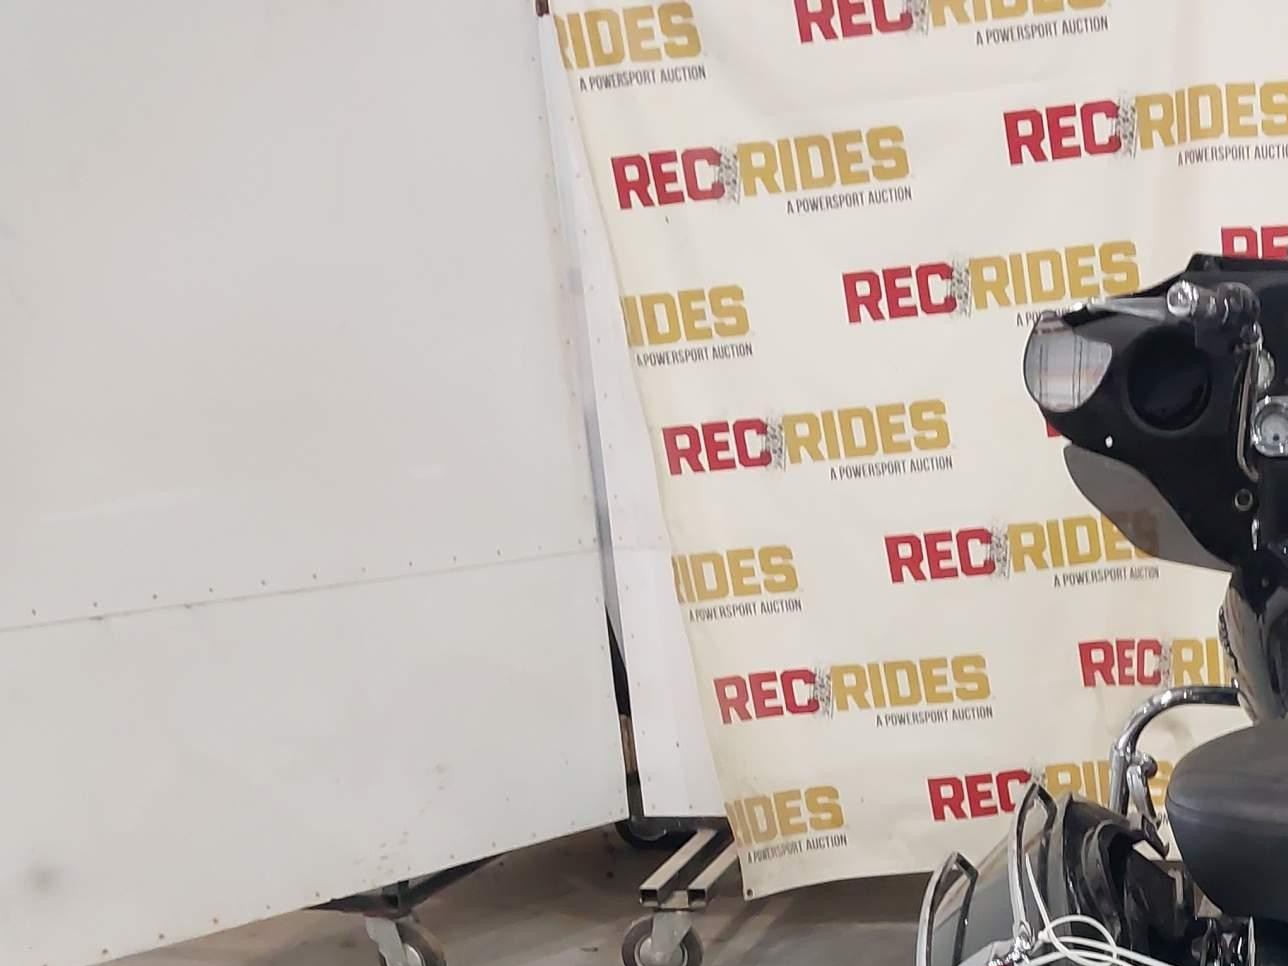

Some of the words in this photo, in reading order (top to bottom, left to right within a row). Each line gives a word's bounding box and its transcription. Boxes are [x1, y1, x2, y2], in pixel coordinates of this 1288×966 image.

[794, 0, 912, 43] REC
[976, 30, 984, 46] A
[985, 20, 1058, 45] POWERSPORT
[1061, 15, 1109, 36] AUCTION
[579, 76, 588, 92] A
[588, 68, 656, 91] POWERSPORT
[660, 64, 707, 84] AUCTION
[1003, 100, 1122, 166] REC
[1177, 151, 1184, 167] A
[1184, 144, 1250, 165] POWERSPORT
[611, 149, 724, 210] REC
[735, 125, 910, 197] RIDES
[786, 199, 795, 215] A
[795, 191, 865, 214] POWERSPORT
[868, 185, 913, 206] AUCTION
[842, 261, 958, 324] REC
[966, 239, 1141, 311] RIDES
[621, 285, 750, 348] IDES
[636, 353, 645, 367] A
[642, 346, 709, 367] POWERSPORT
[711, 342, 753, 361] AUCTION
[662, 418, 773, 476] REC
[778, 398, 951, 464] RIDES
[830, 466, 838, 481] A
[838, 459, 906, 481] POWERSPORT
[909, 455, 953, 473] AUCTION
[884, 527, 997, 584] REC
[1005, 512, 1160, 573] RIDE
[670, 545, 800, 604] IDES
[1053, 573, 1061, 588] A
[1062, 566, 1127, 587] POWERSPORT
[689, 608, 697, 622] A
[694, 601, 757, 622] POWERSPORT
[760, 598, 803, 615] AUCTION
[1077, 639, 1163, 688] REC
[714, 668, 821, 725] REC
[827, 654, 991, 711] RIDES
[876, 713, 883, 728] A
[884, 708, 949, 728] POWERSPORT
[951, 705, 993, 721] AUCTION
[723, 784, 846, 849] IDES
[927, 768, 1032, 822] REC
[805, 833, 848, 851] AUCTION
